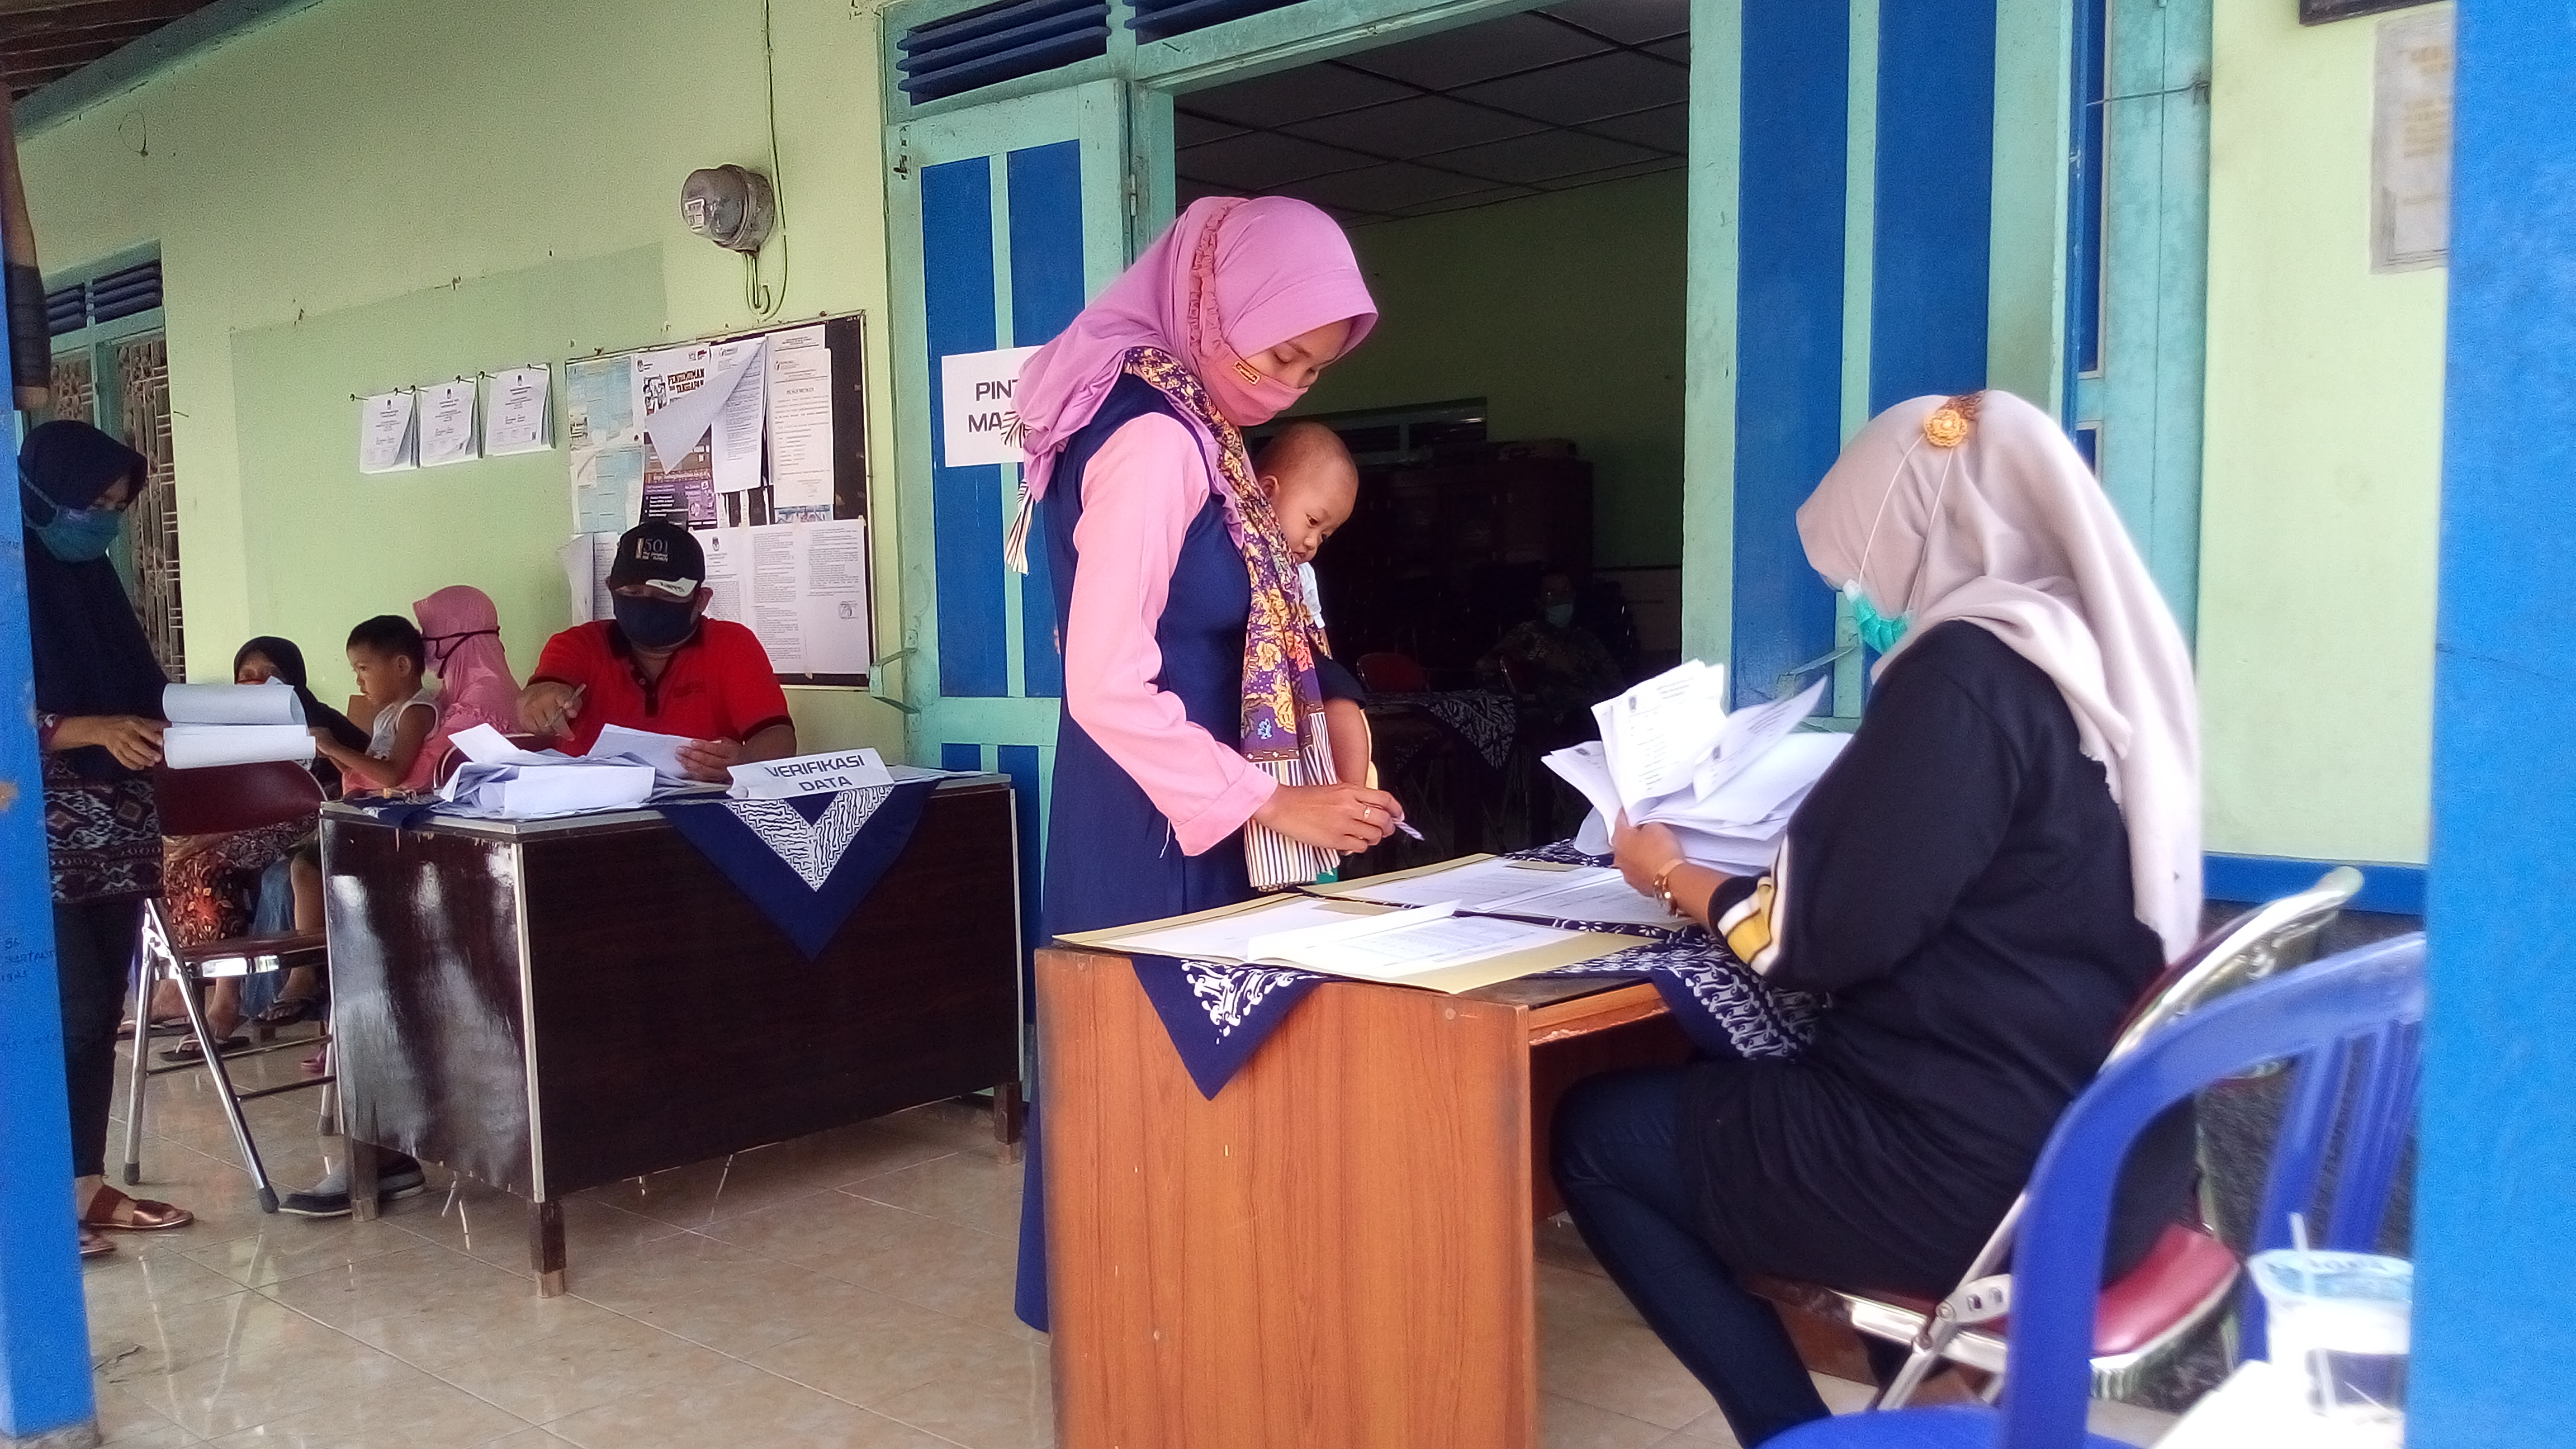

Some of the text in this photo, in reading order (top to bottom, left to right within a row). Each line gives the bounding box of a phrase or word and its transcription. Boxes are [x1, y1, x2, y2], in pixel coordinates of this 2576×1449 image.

[976, 378, 1019, 401] PIN
[968, 412, 1002, 433] MA
[765, 755, 865, 778] VERIFIKASI
[799, 776, 853, 792] DATA
